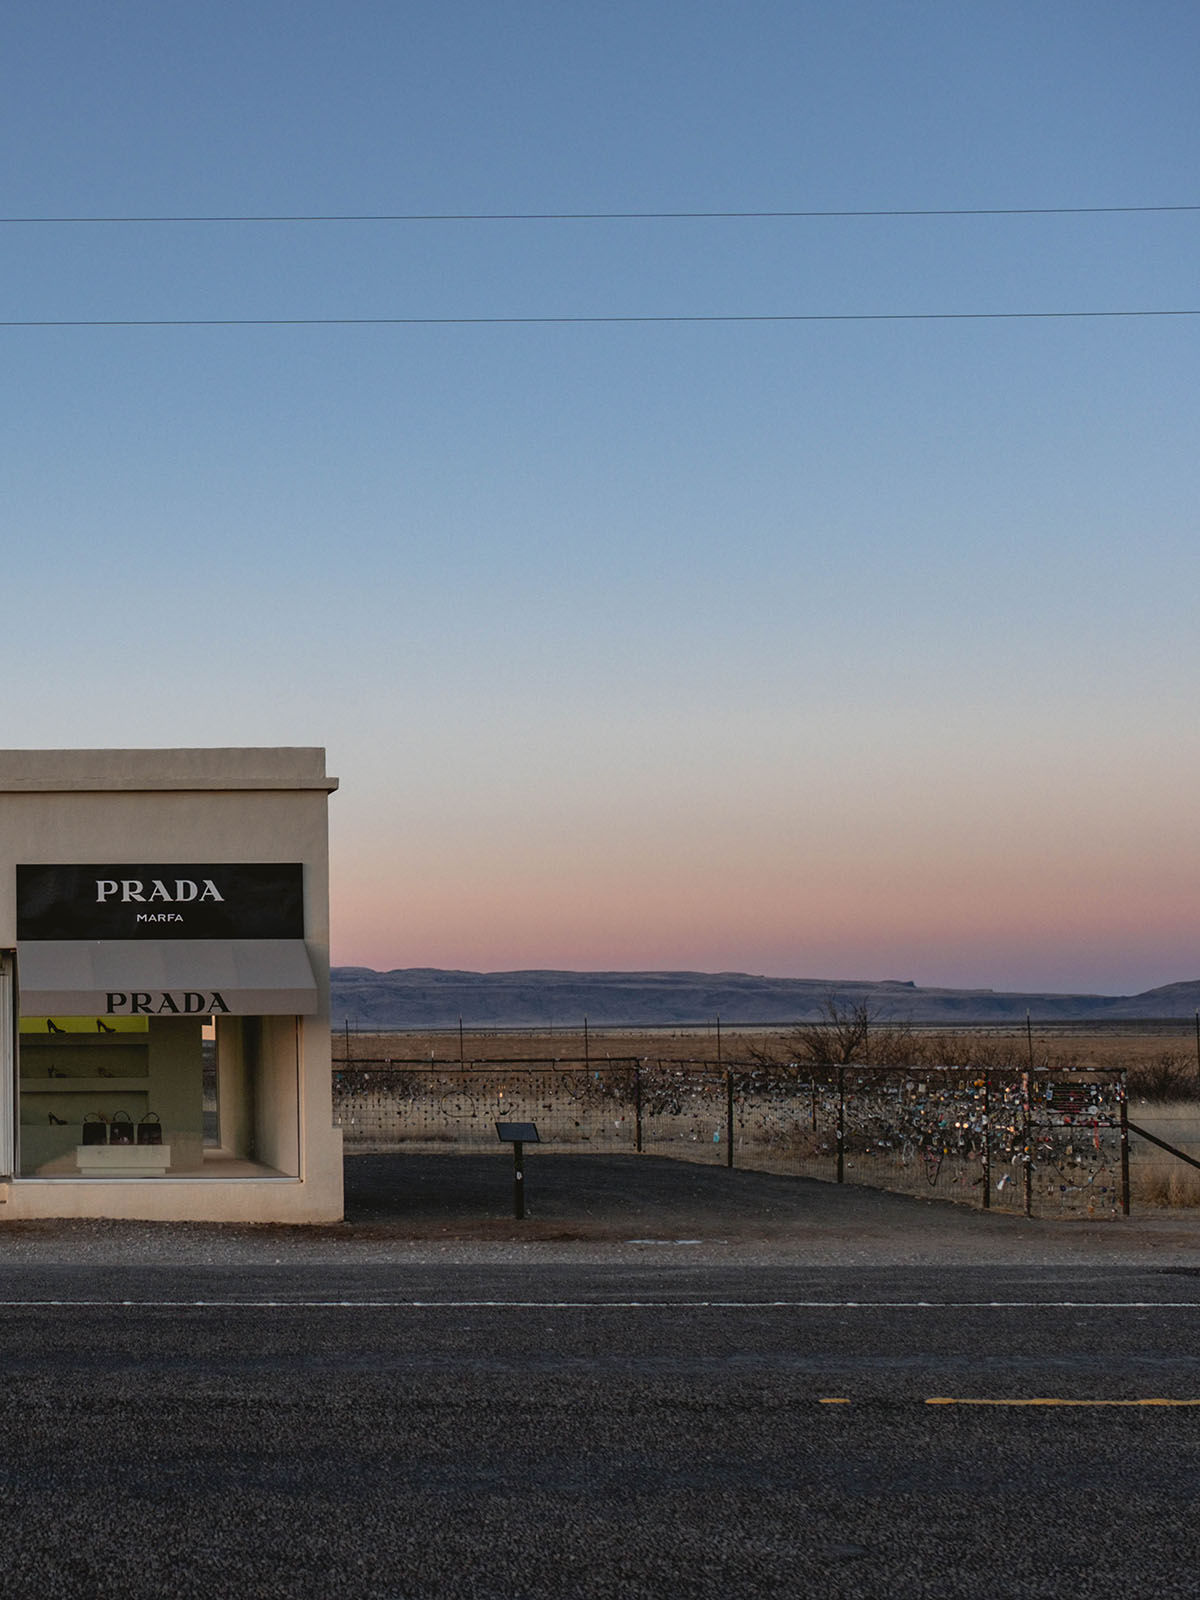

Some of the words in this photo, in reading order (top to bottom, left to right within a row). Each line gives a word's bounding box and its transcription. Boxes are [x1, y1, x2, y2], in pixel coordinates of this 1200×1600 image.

[95, 880, 225, 903] PRADA
[136, 913, 184, 923] MARFA
[105, 992, 231, 1014] PRADA
